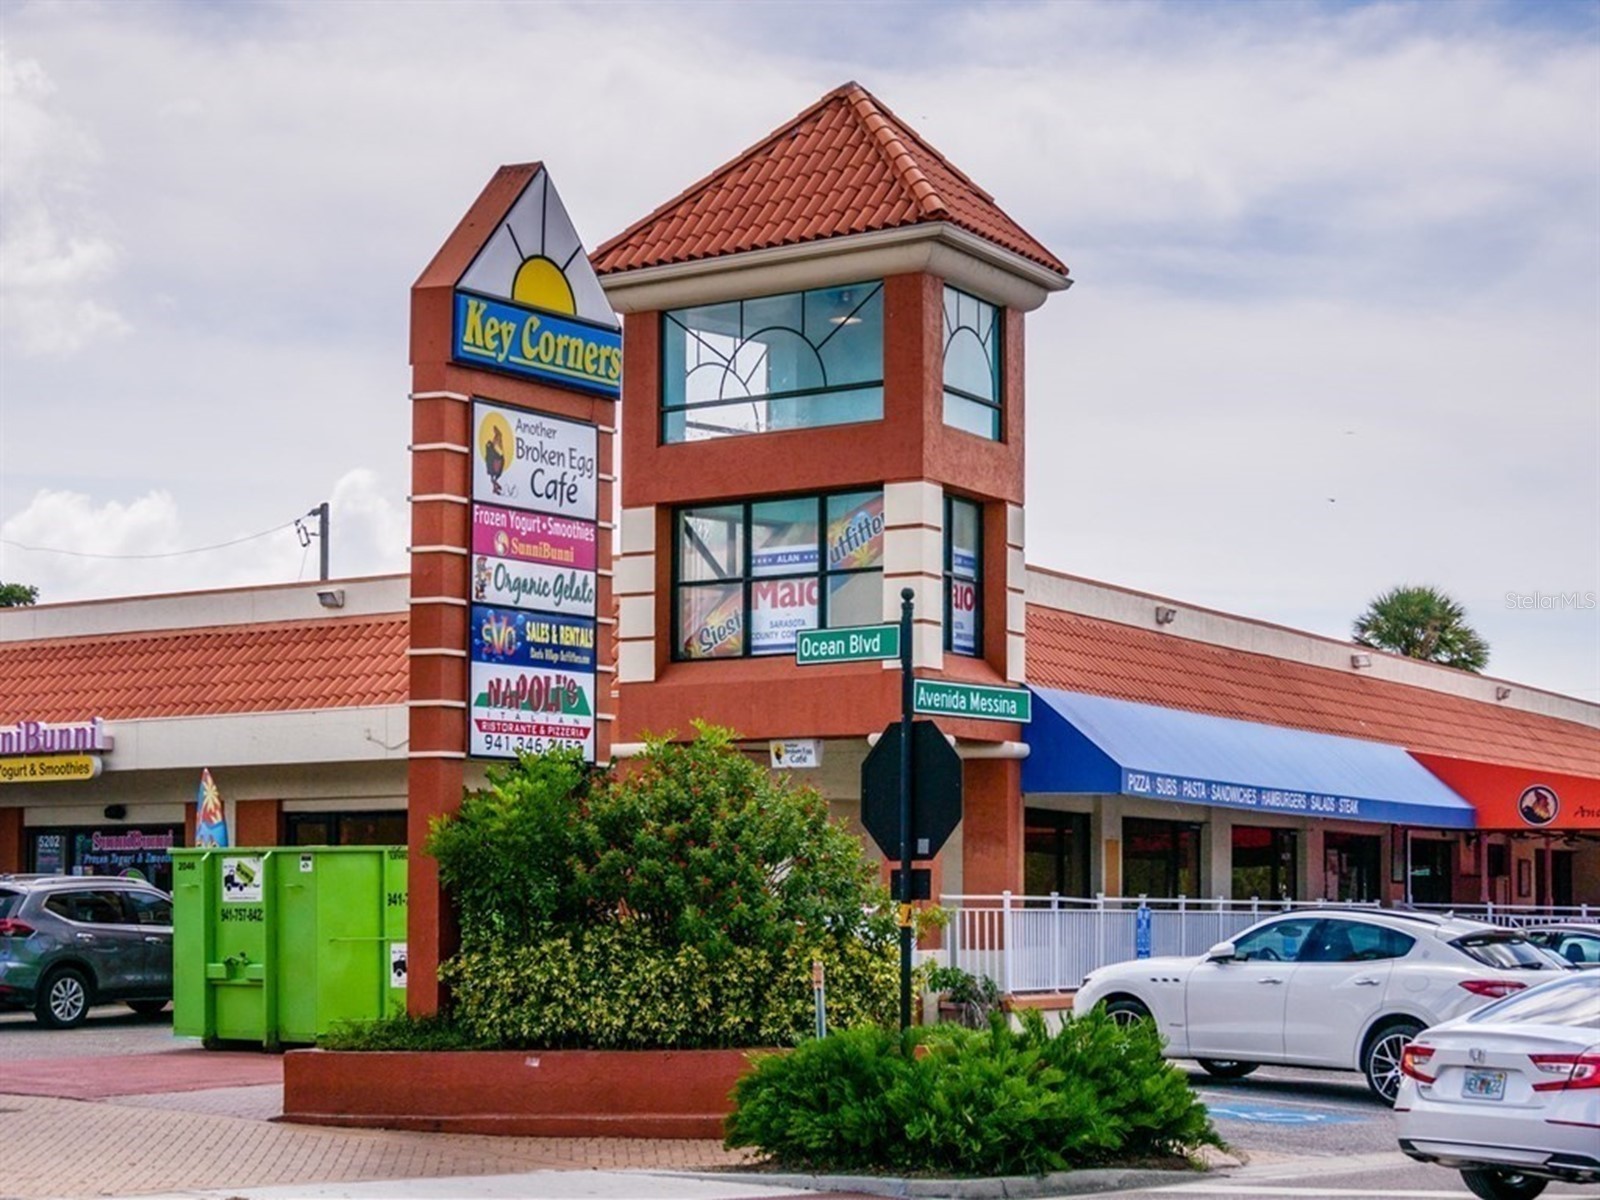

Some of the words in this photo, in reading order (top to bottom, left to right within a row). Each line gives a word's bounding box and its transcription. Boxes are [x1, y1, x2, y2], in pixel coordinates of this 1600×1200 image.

[463, 299, 517, 362] Key
[521, 316, 622, 379] Corners
[515, 418, 557, 439] Another
[516, 437, 565, 467] Broken
[568, 447, 594, 479] Egg
[530, 468, 578, 508] Café
[473, 505, 507, 528] Frozen
[508, 511, 541, 536] Yogurt
[547, 516, 595, 542] Smoothies
[511, 537, 575, 562] SunniBunni
[777, 554, 800, 563] ALAN
[494, 562, 551, 605] Organic
[526, 621, 550, 644] SALES
[551, 623, 558, 644] &
[559, 625, 594, 649] RENTALS
[769, 618, 807, 629] SARASOTA
[801, 638, 845, 657] Ocean
[850, 633, 881, 654] Blvd
[917, 686, 966, 710] Avenida
[969, 691, 1017, 715] Messina
[481, 721, 538, 735] RISTORANTE
[539, 726, 546, 735] &
[547, 727, 586, 738] PIZZERIA
[487, 711, 580, 724] ITALIAN
[29, 763, 36, 776] &
[39, 760, 90, 776] Smoothies
[1128, 773, 1151, 792] PIZZA
[1156, 777, 1177, 796] SUBS
[1183, 780, 1206, 799] PASTA
[1211, 784, 1257, 805] SANDWICHES
[1261, 789, 1307, 809] HAMBURGERS
[1311, 795, 1335, 812] SALADS
[1339, 798, 1359, 814] STEAK
[39, 835, 60, 849] 5202
